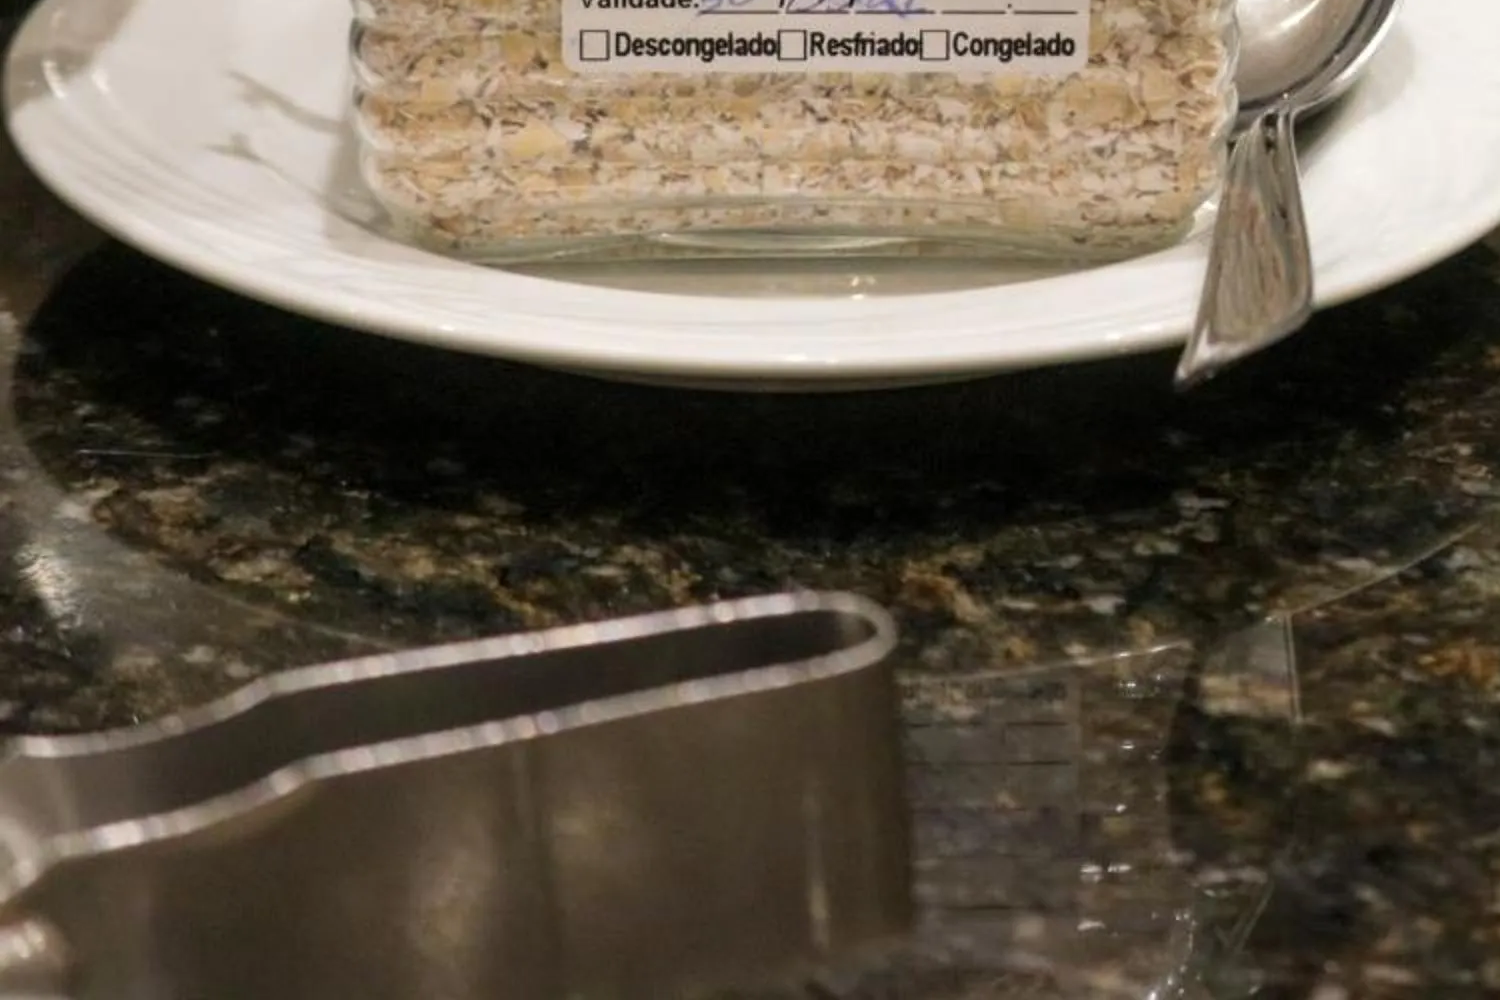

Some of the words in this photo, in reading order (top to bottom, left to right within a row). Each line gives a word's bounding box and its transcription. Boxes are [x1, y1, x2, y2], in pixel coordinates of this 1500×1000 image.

[614, 30, 777, 63] Descongelado
[810, 30, 920, 58] Resfriado
[953, 30, 1075, 63] Congelado
